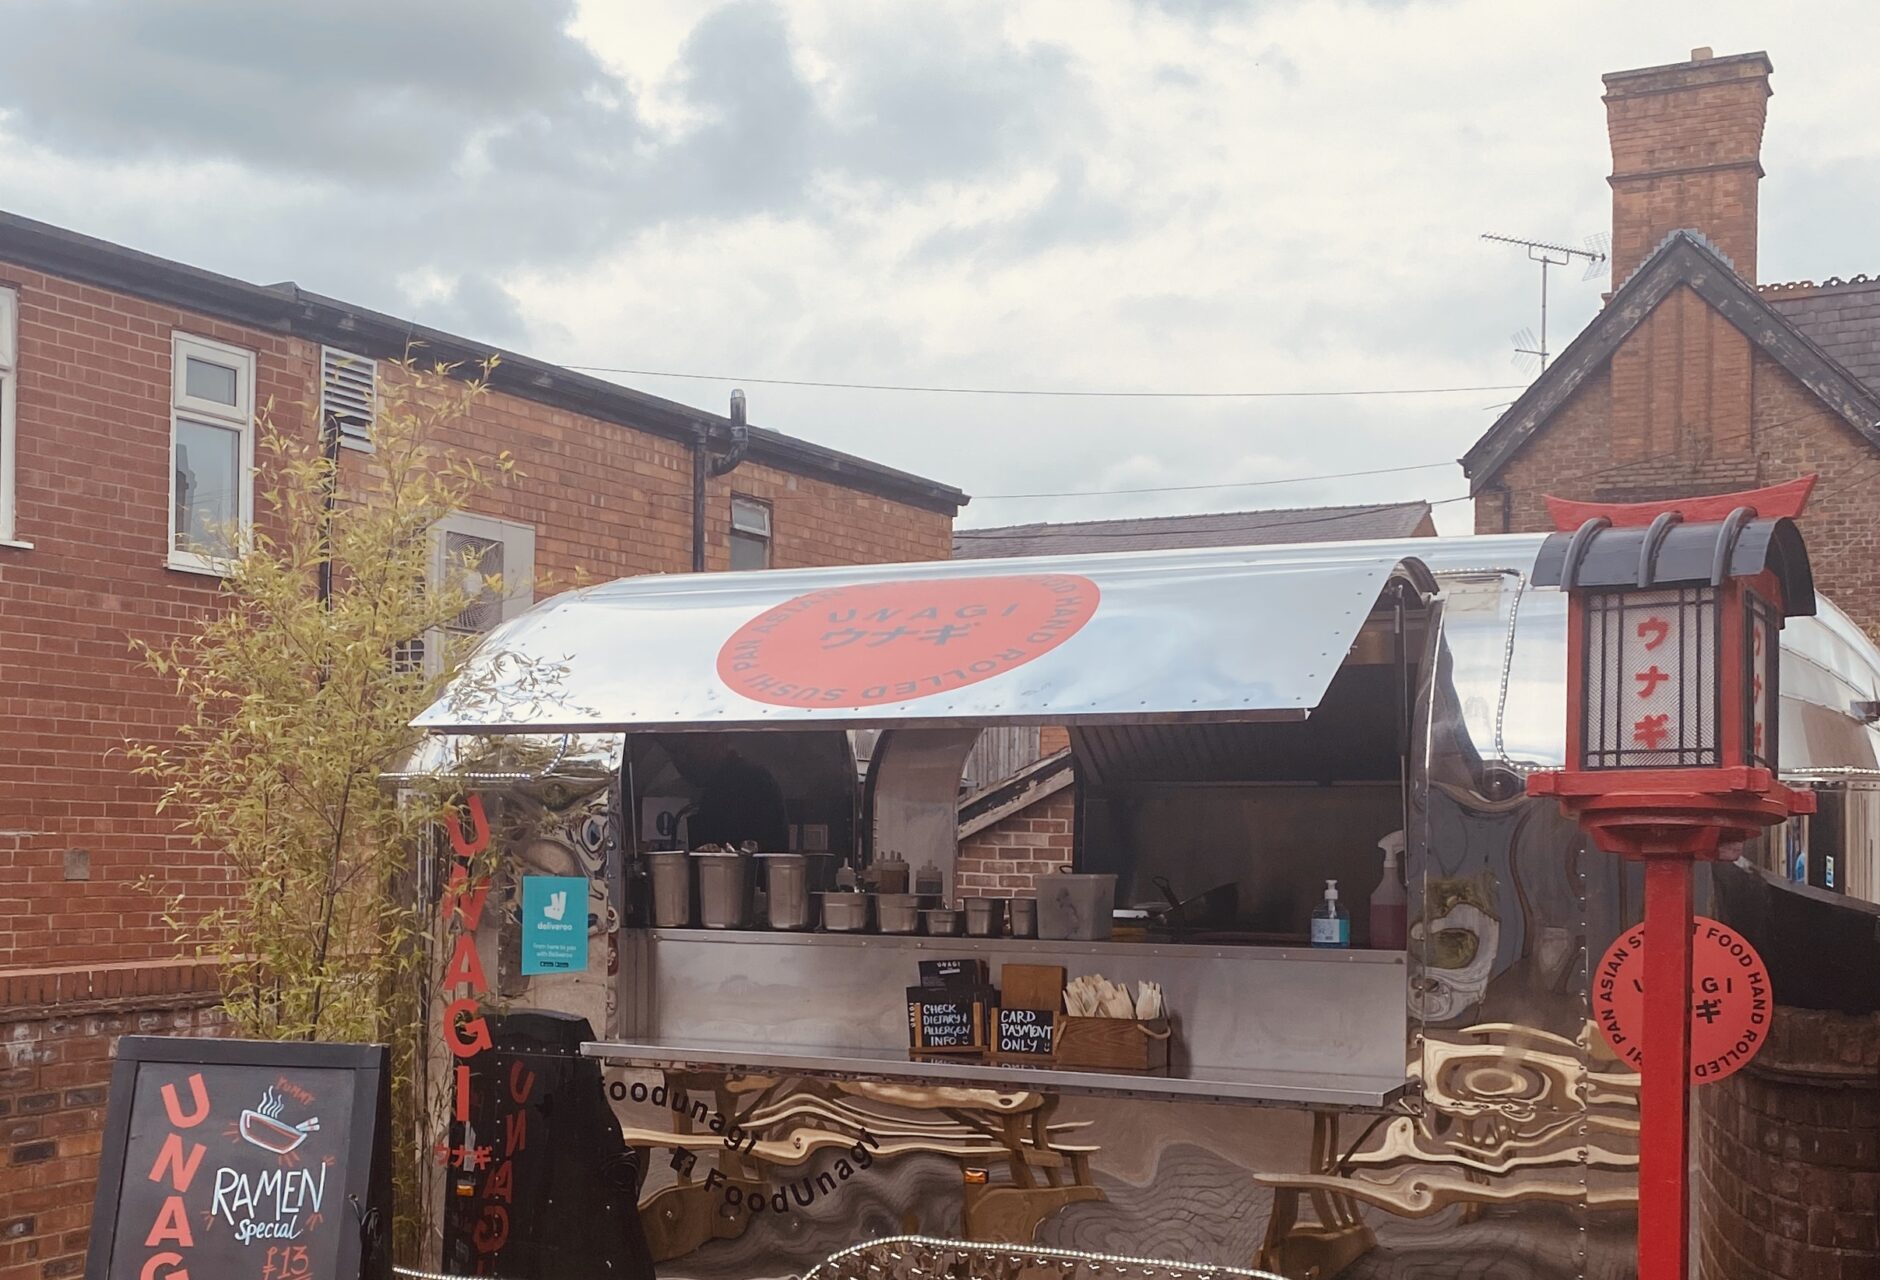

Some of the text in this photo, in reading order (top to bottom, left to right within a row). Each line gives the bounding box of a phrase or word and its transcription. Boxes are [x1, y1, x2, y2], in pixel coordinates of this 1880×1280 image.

[829, 602, 1020, 623] UNAGI
[1026, 595, 1085, 644] HAND
[821, 622, 980, 650] ウナギ
[733, 639, 762, 673] PAN
[743, 673, 848, 702] SUSHI
[861, 648, 1026, 699] ROLLED
[1632, 616, 1670, 750] ウナギ
[537, 921, 573, 930] deliveroo
[442, 794, 492, 1122] UNAGI
[1706, 927, 1753, 968] FOOD
[1600, 948, 1630, 1002] ASIAN
[923, 1004, 957, 1015] CHECK
[1748, 971, 1766, 1025] HAND
[923, 1014, 961, 1025] DIETARY
[924, 1024, 971, 1037] ALLERGEN
[1001, 1010, 1036, 1023] CARD
[1001, 1023, 1053, 1040] PAYMENT
[1601, 1009, 1626, 1045] PAN
[930, 1036, 957, 1047] INFO
[1001, 1038, 1038, 1052] ONLY
[1694, 1029, 1758, 1078] ROLLED
[601, 1077, 757, 1155] oodunagi
[432, 1145, 493, 1171] ウナギ
[704, 1127, 880, 1214] FoodUnagi
[211, 1162, 327, 1226] RAMEN
